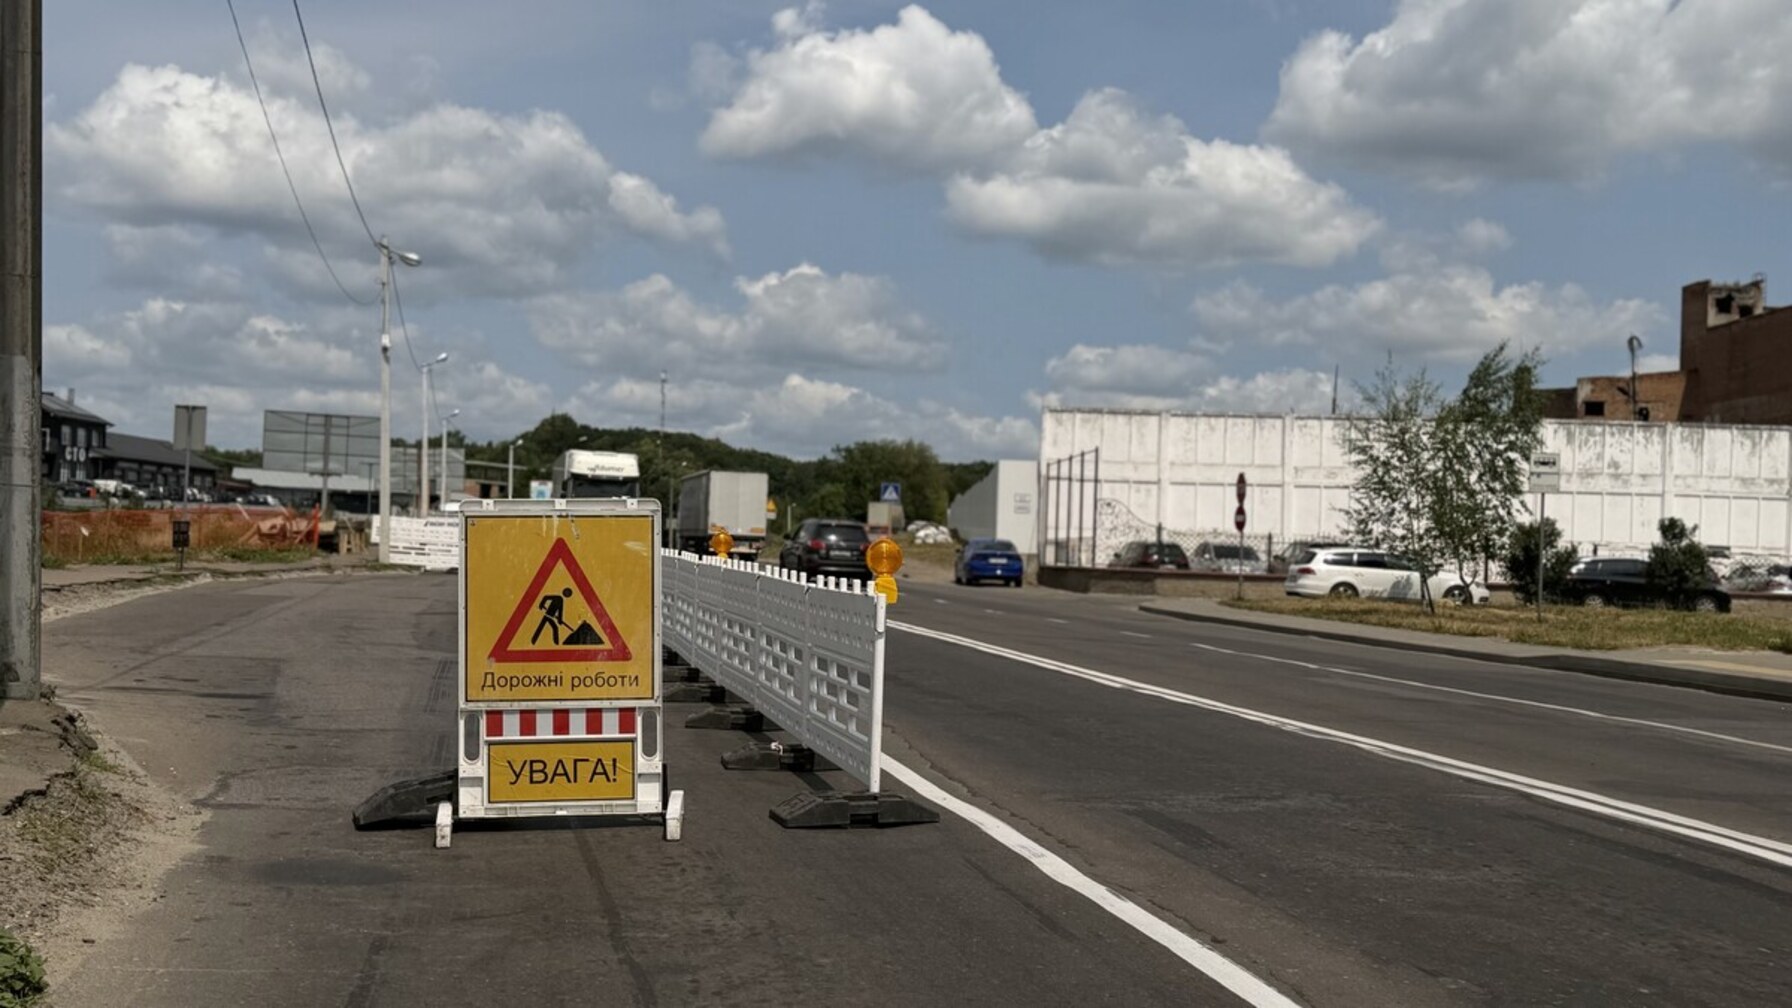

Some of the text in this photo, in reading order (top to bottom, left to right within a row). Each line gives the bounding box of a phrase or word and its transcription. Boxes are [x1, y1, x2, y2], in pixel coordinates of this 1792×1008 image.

[65, 446, 86, 462] СТО
[481, 671, 639, 691] Дорожні роботи
[507, 757, 617, 785] УВАГА!
